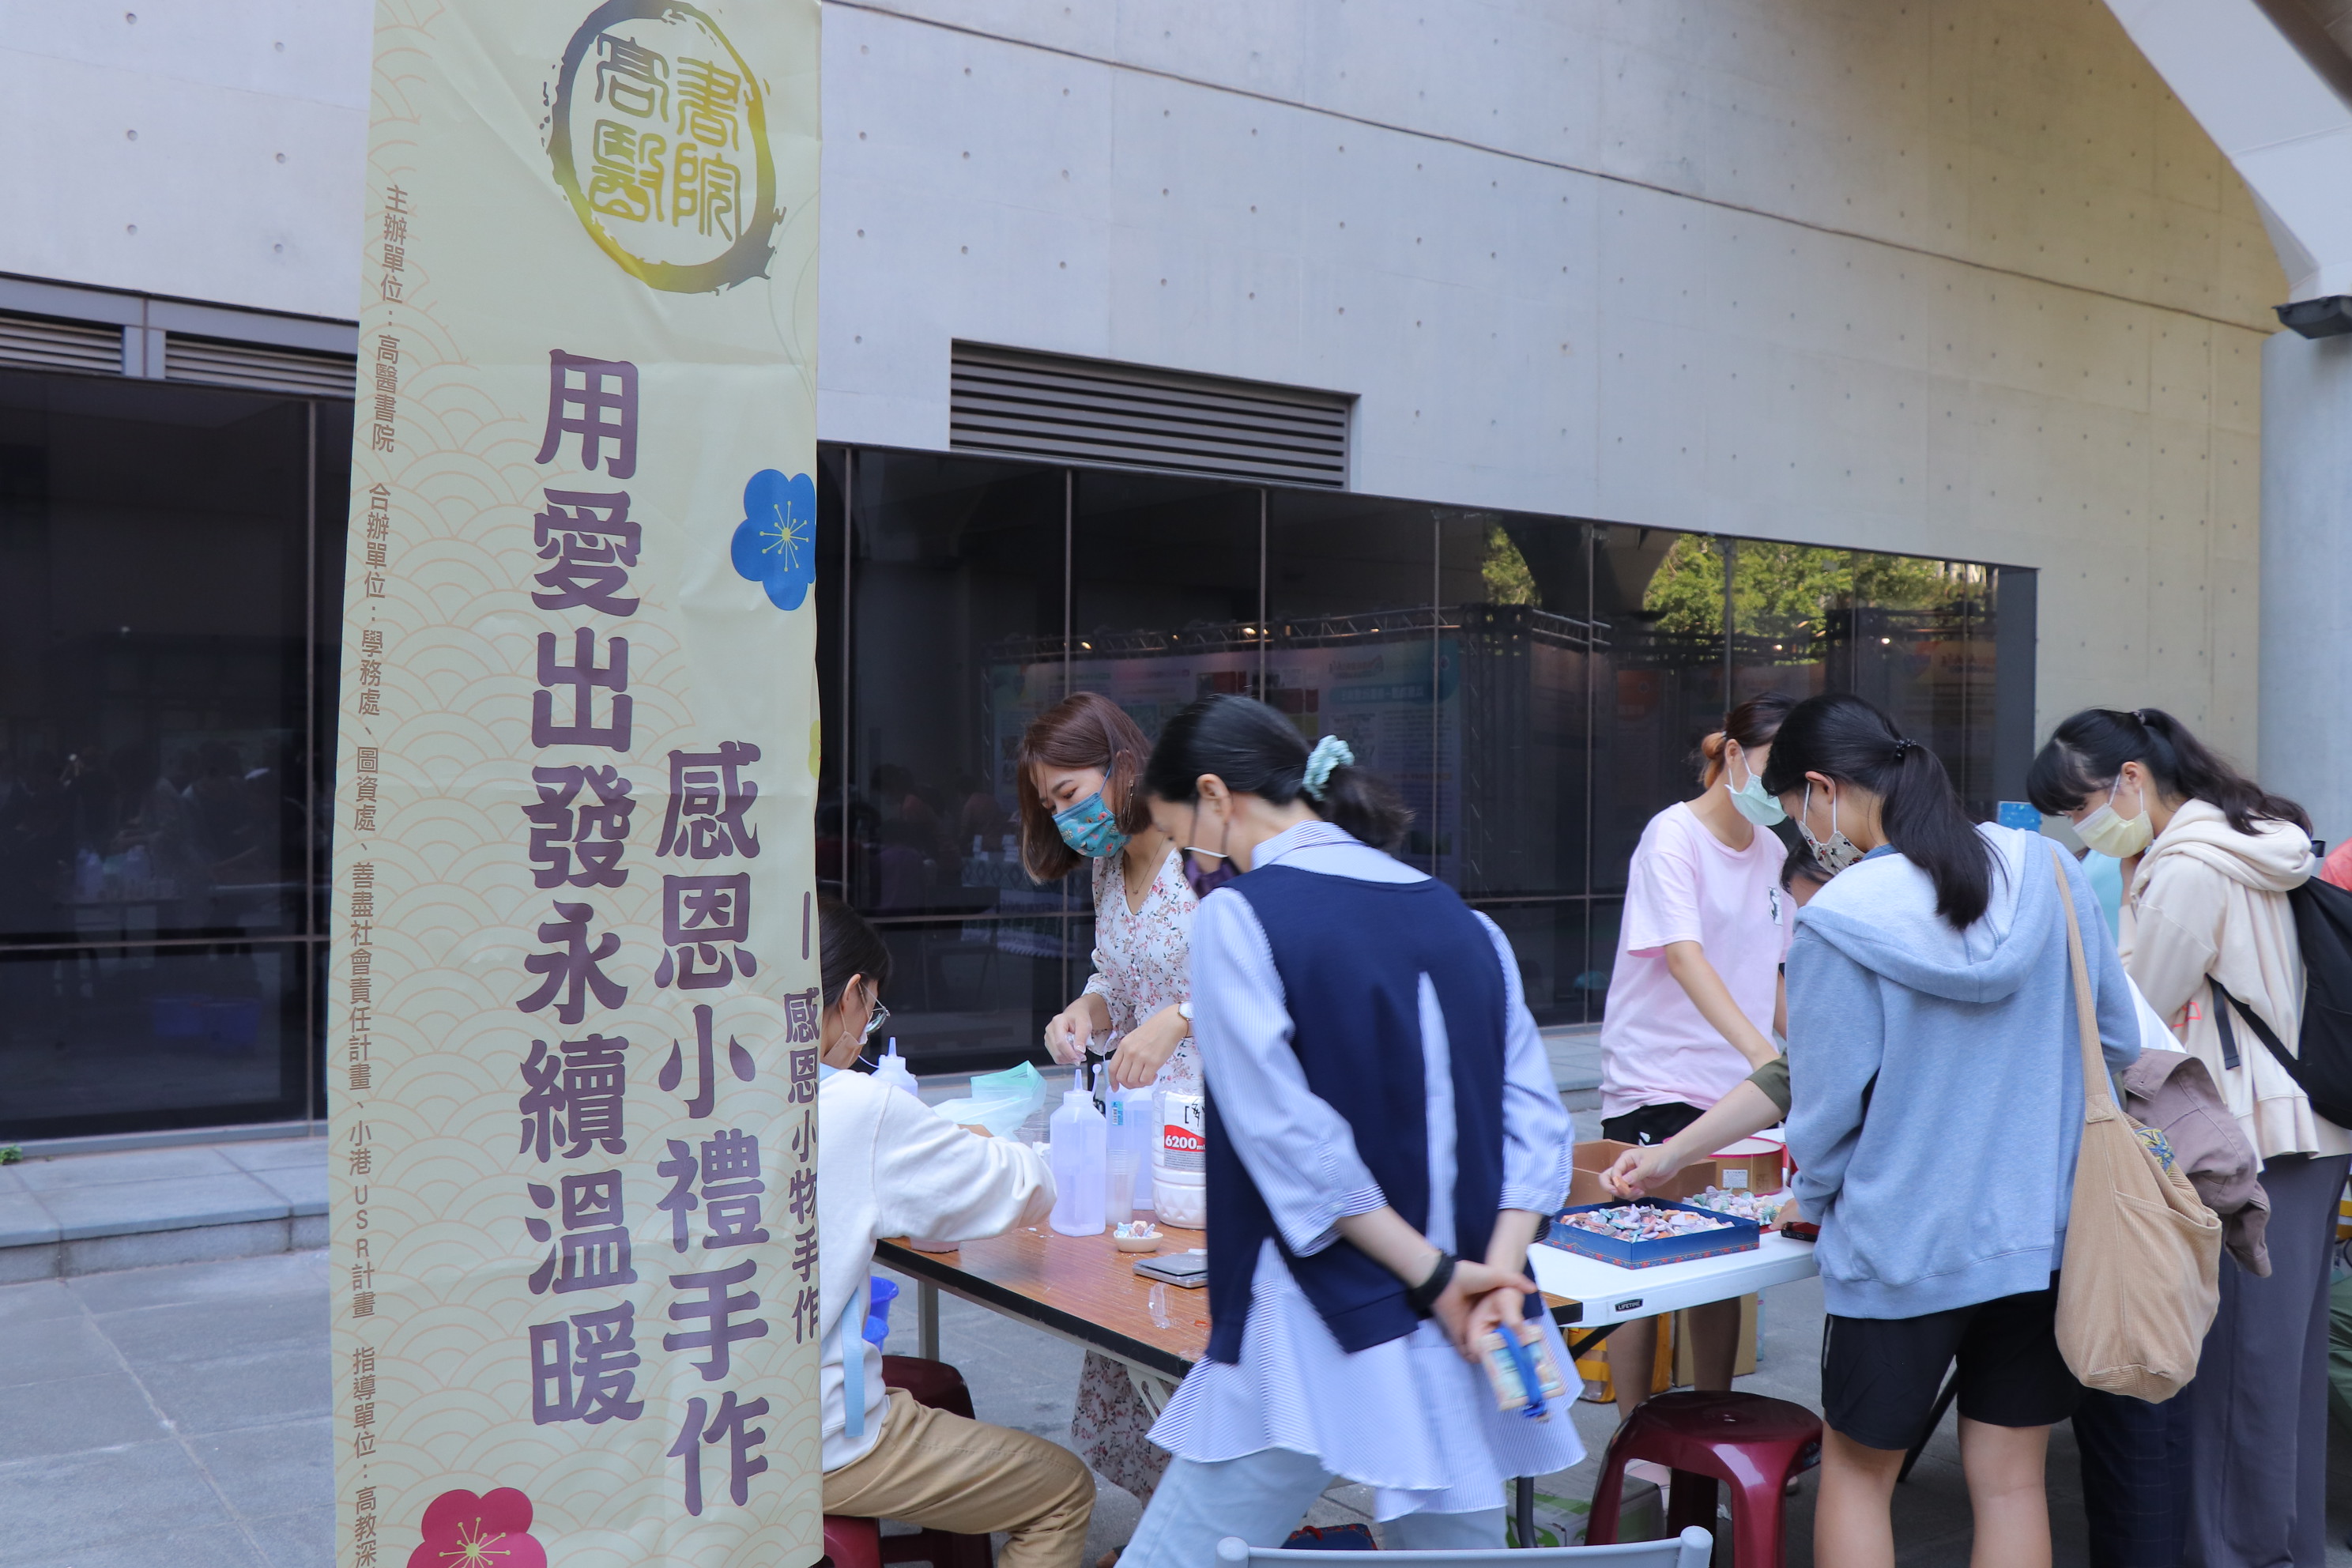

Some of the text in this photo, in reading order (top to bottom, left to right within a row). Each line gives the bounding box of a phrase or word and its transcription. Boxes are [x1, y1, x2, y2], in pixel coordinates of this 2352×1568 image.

[516, 349, 644, 1426] 用愛出發永續溫暖
[654, 741, 770, 1517] 感恩小禮手作
[352, 1346, 377, 1568] 指導單位：高教深
